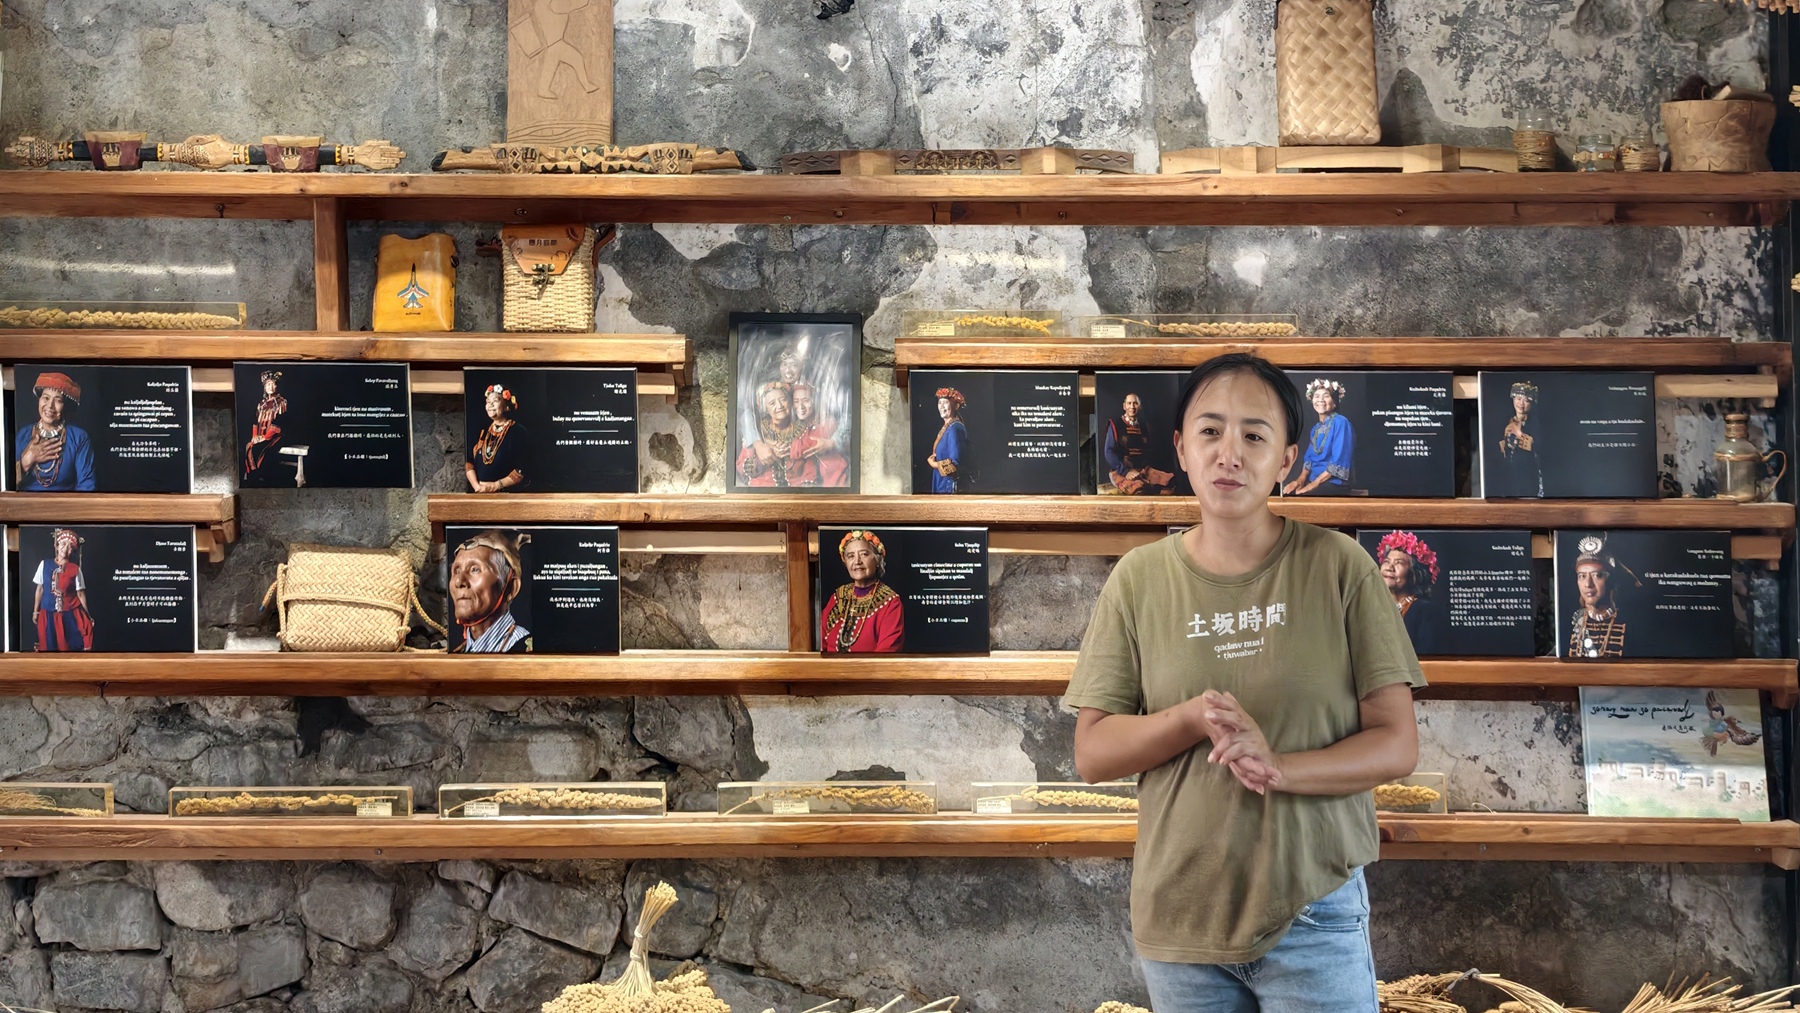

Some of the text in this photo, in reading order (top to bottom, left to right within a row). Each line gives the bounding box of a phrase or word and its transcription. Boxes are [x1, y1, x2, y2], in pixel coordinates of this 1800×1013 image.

[1186, 602, 1286, 638] 土坂時間
[1214, 641, 1243, 653] qadaw
[1244, 640, 1260, 648] nua
